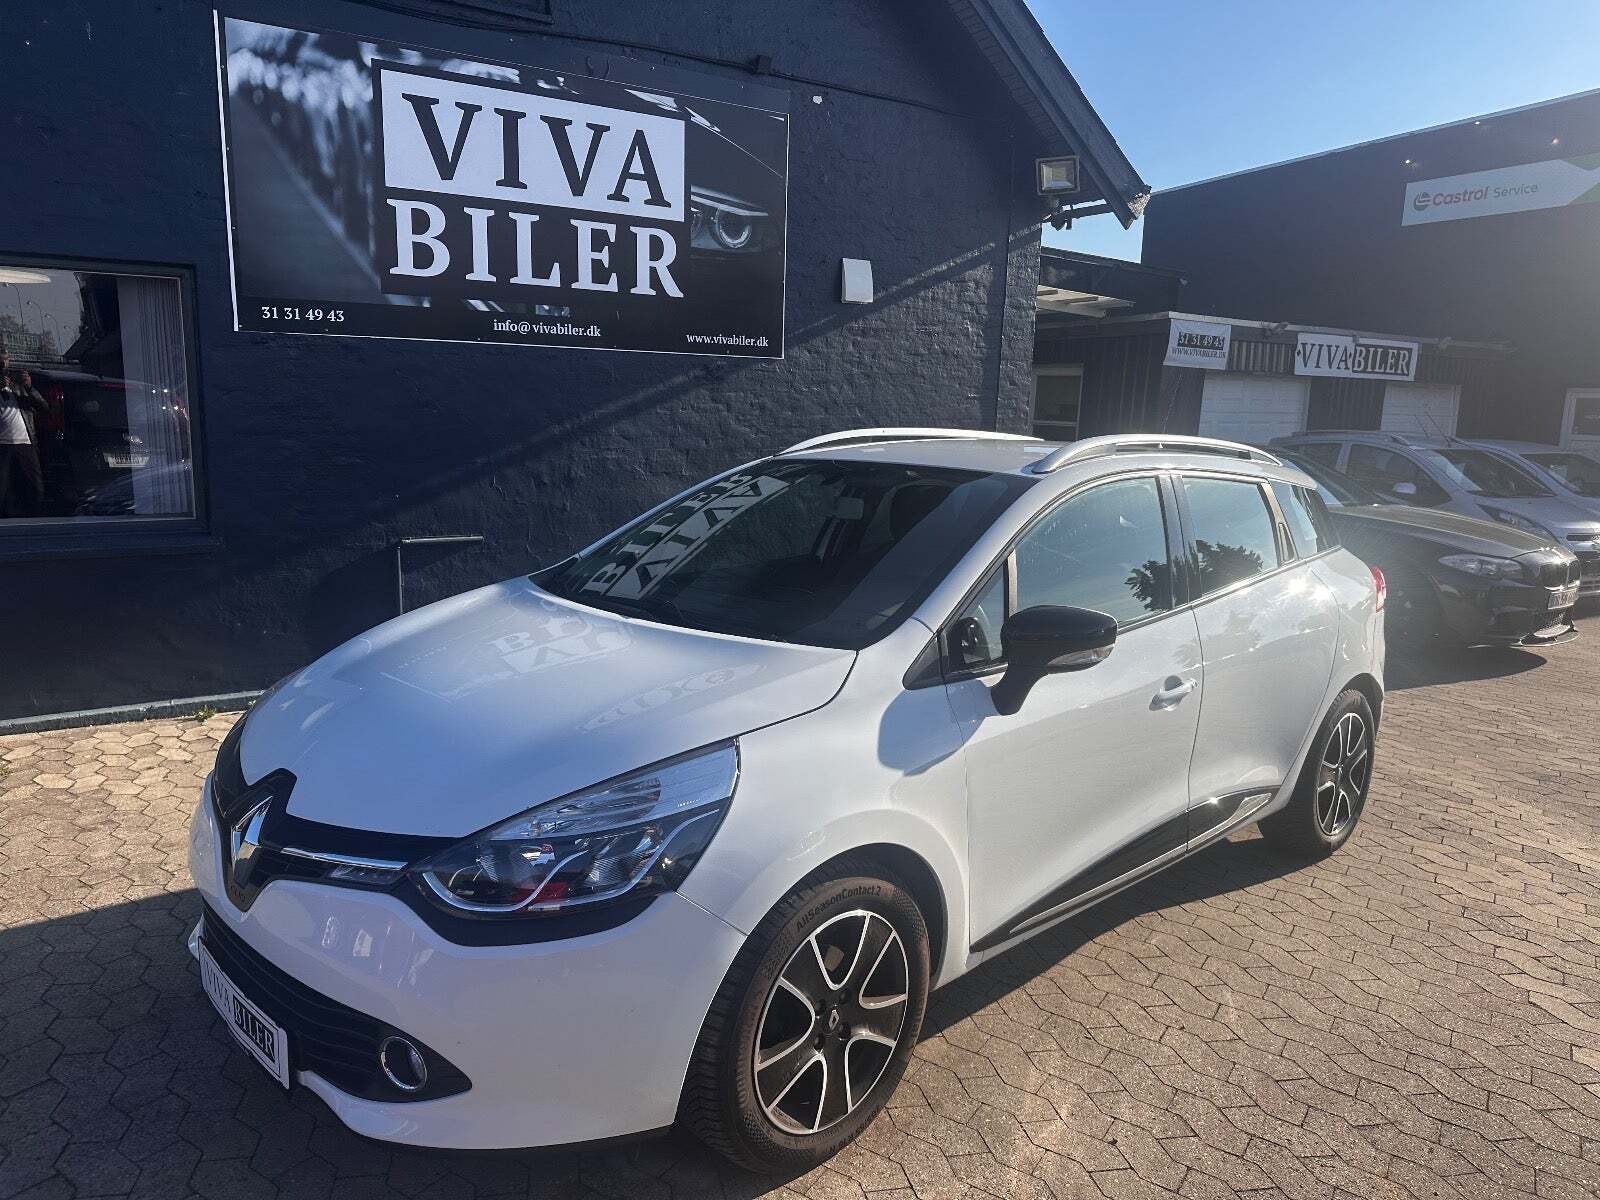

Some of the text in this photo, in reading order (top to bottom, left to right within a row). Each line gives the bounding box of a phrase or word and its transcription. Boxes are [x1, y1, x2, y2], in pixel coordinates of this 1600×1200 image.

[401, 92, 671, 208] VIVA
[1432, 183, 1538, 206] Castrol Service
[386, 198, 684, 298] BILER
[262, 306, 345, 322] 31 31 49 43
[493, 319, 601, 337] info@vivabiler.dk
[686, 333, 769, 347] www.vivabiler.dk
[1301, 342, 1409, 374] VIVA BILER
[233, 1000, 275, 1059] BILER
